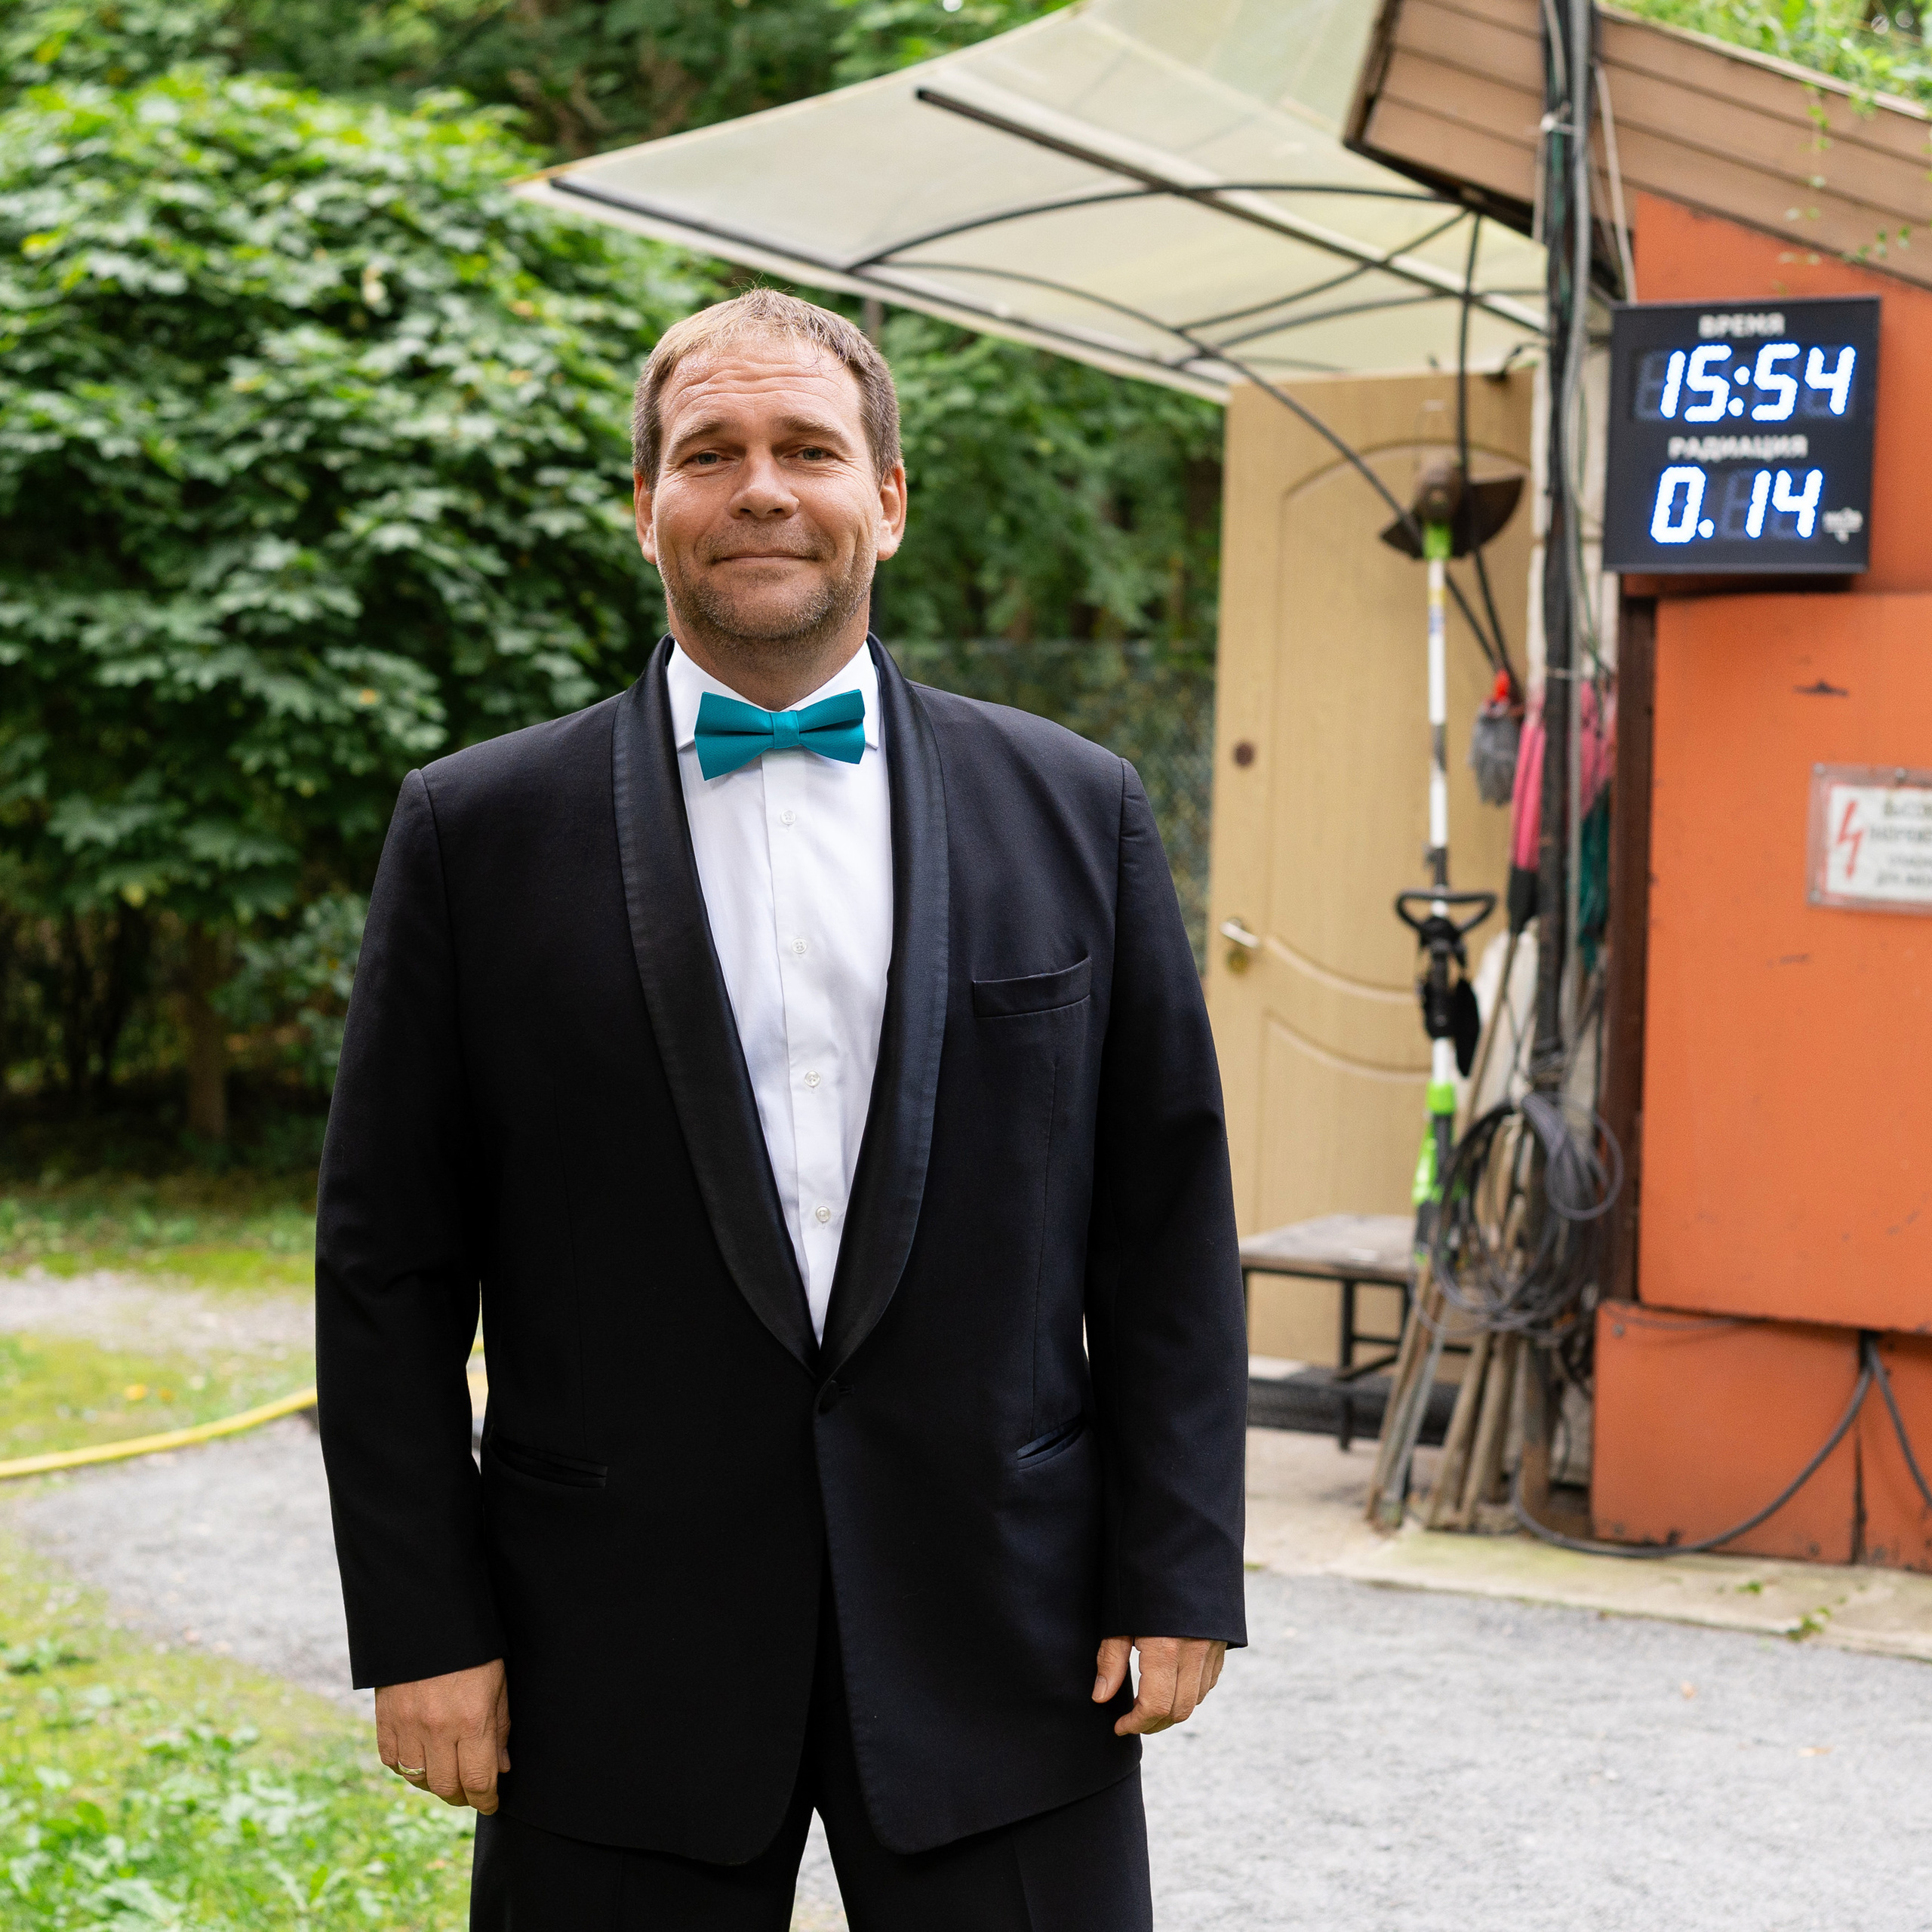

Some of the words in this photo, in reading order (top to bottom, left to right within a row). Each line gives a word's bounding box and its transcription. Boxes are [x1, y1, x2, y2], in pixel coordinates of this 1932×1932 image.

[1698, 312, 1785, 338] ВРЕМЯ
[1660, 343, 1856, 423] 15:54
[1668, 433, 1808, 463] РАДИАЦИЯ
